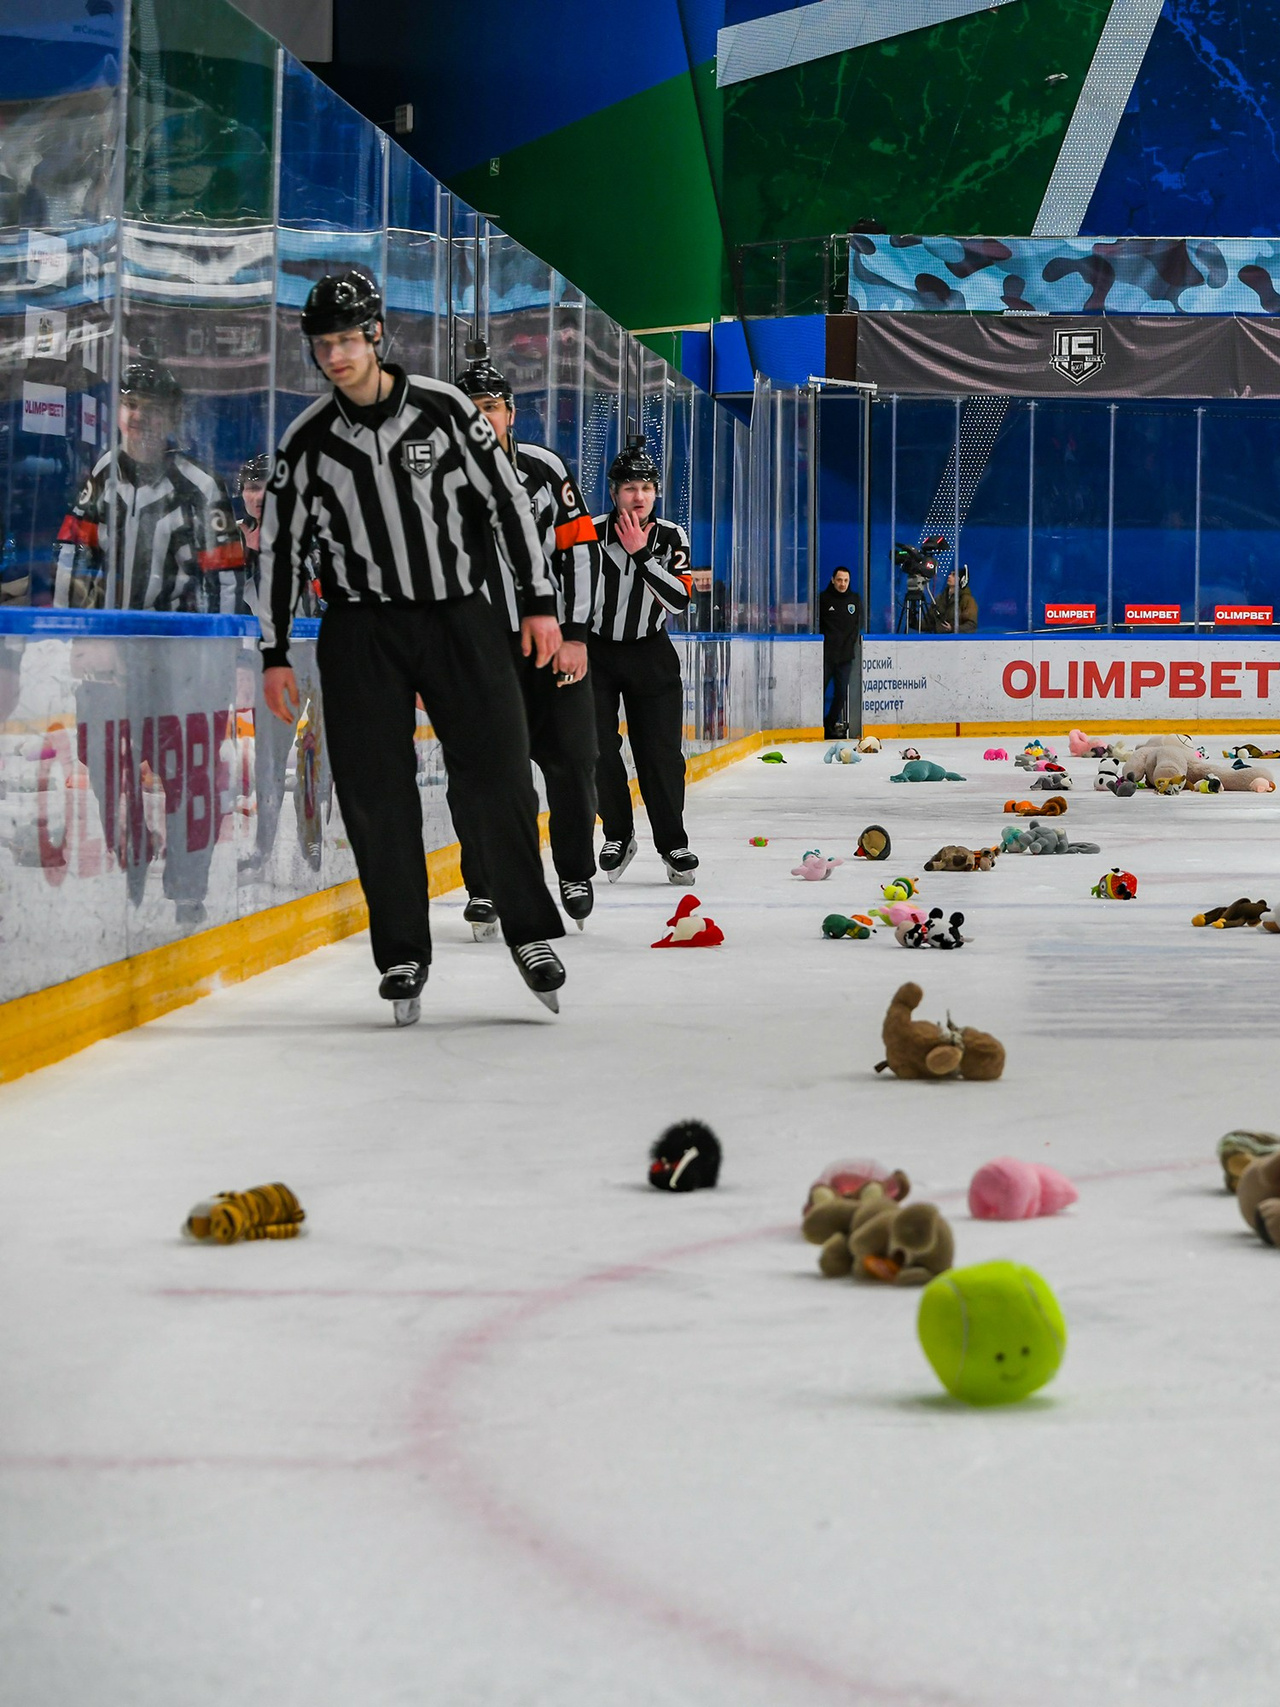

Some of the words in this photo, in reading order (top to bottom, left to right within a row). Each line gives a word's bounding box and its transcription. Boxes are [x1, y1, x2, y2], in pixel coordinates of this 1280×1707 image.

[674, 550, 691, 570] 2
[1046, 609, 1095, 620] OLIMPBET
[1126, 609, 1179, 620] OLIMPBET
[1216, 610, 1272, 621] OLIMPBET
